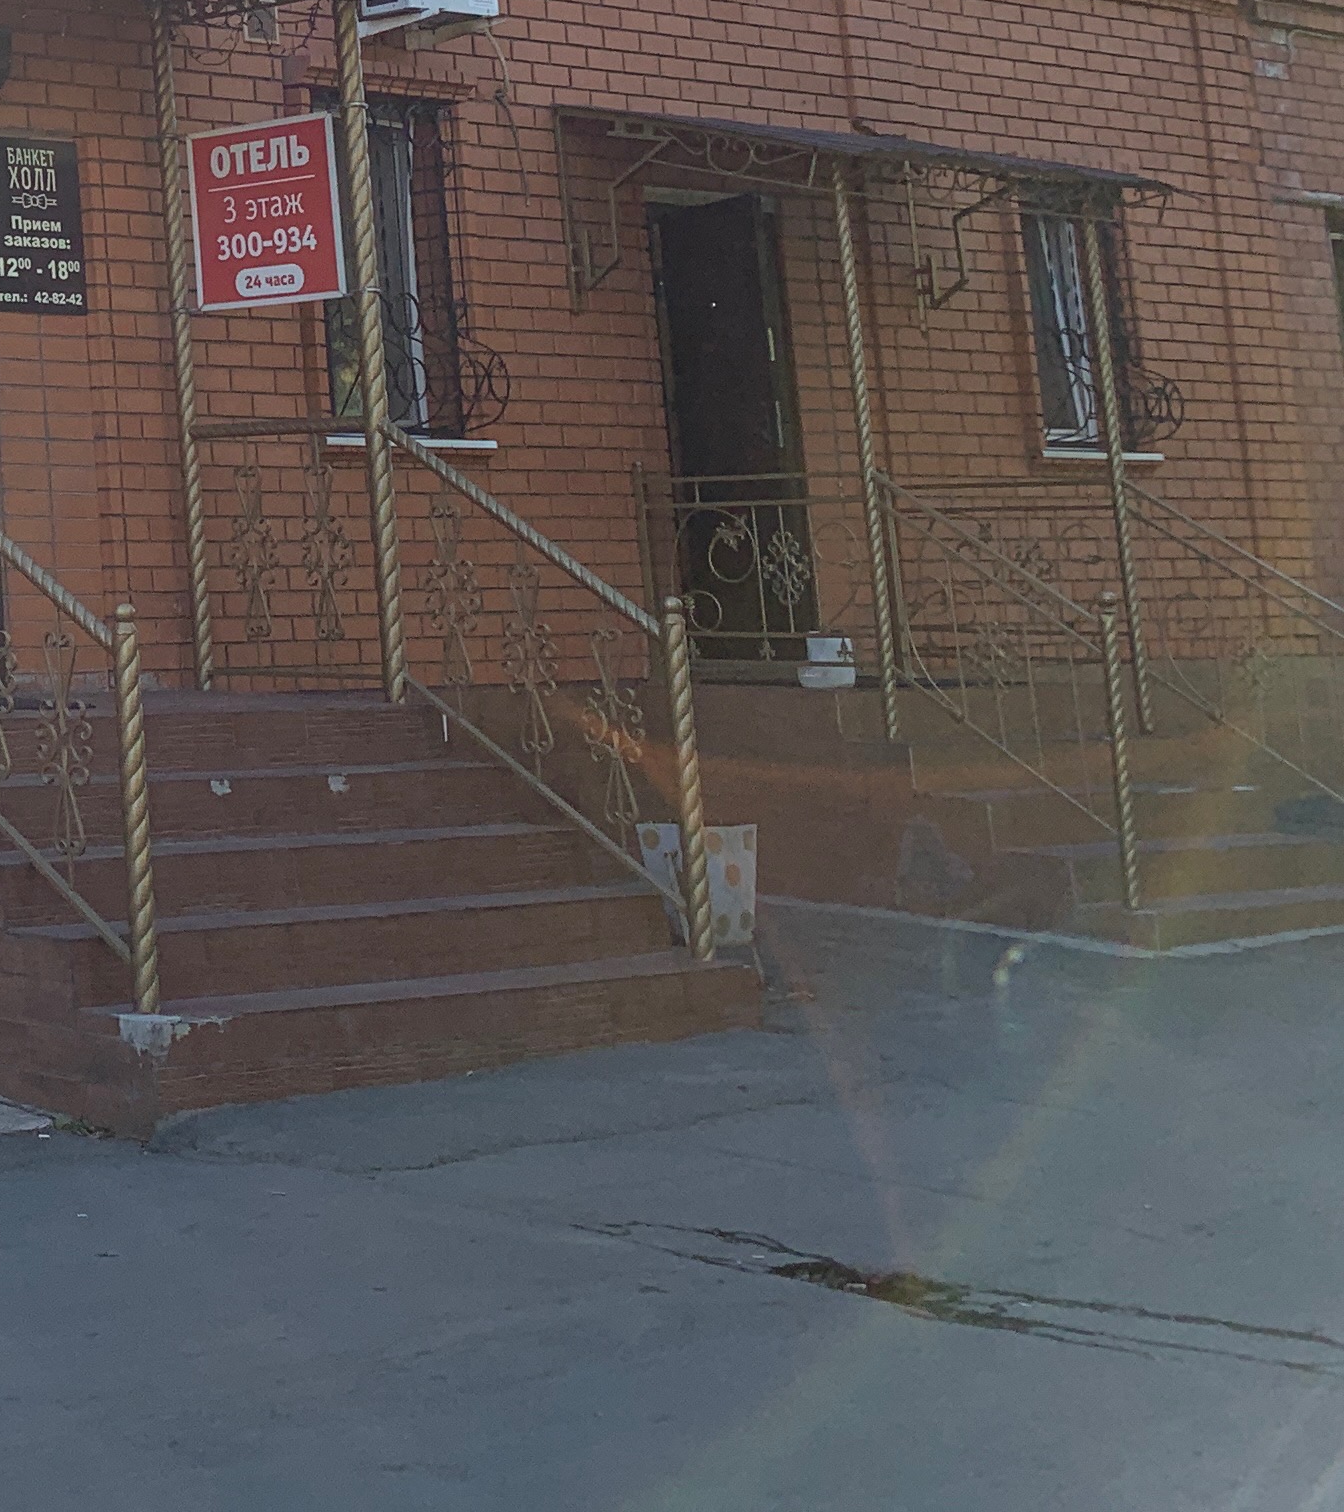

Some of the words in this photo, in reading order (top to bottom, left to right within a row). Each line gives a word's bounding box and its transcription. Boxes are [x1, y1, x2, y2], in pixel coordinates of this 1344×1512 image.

[6, 147, 55, 167] БАНКЕТ
[210, 134, 310, 179] ОТЕЛЬ
[8, 166, 57, 192] ХОЛЛ
[223, 196, 237, 223] 3
[245, 192, 304, 220] этаж
[11, 215, 62, 233] Прием
[4, 234, 71, 249] заказов:
[217, 224, 318, 261] 300-934
[244, 275, 262, 289] 24
[265, 272, 295, 287] часа
[34, 291, 83, 306] 42-82-42
